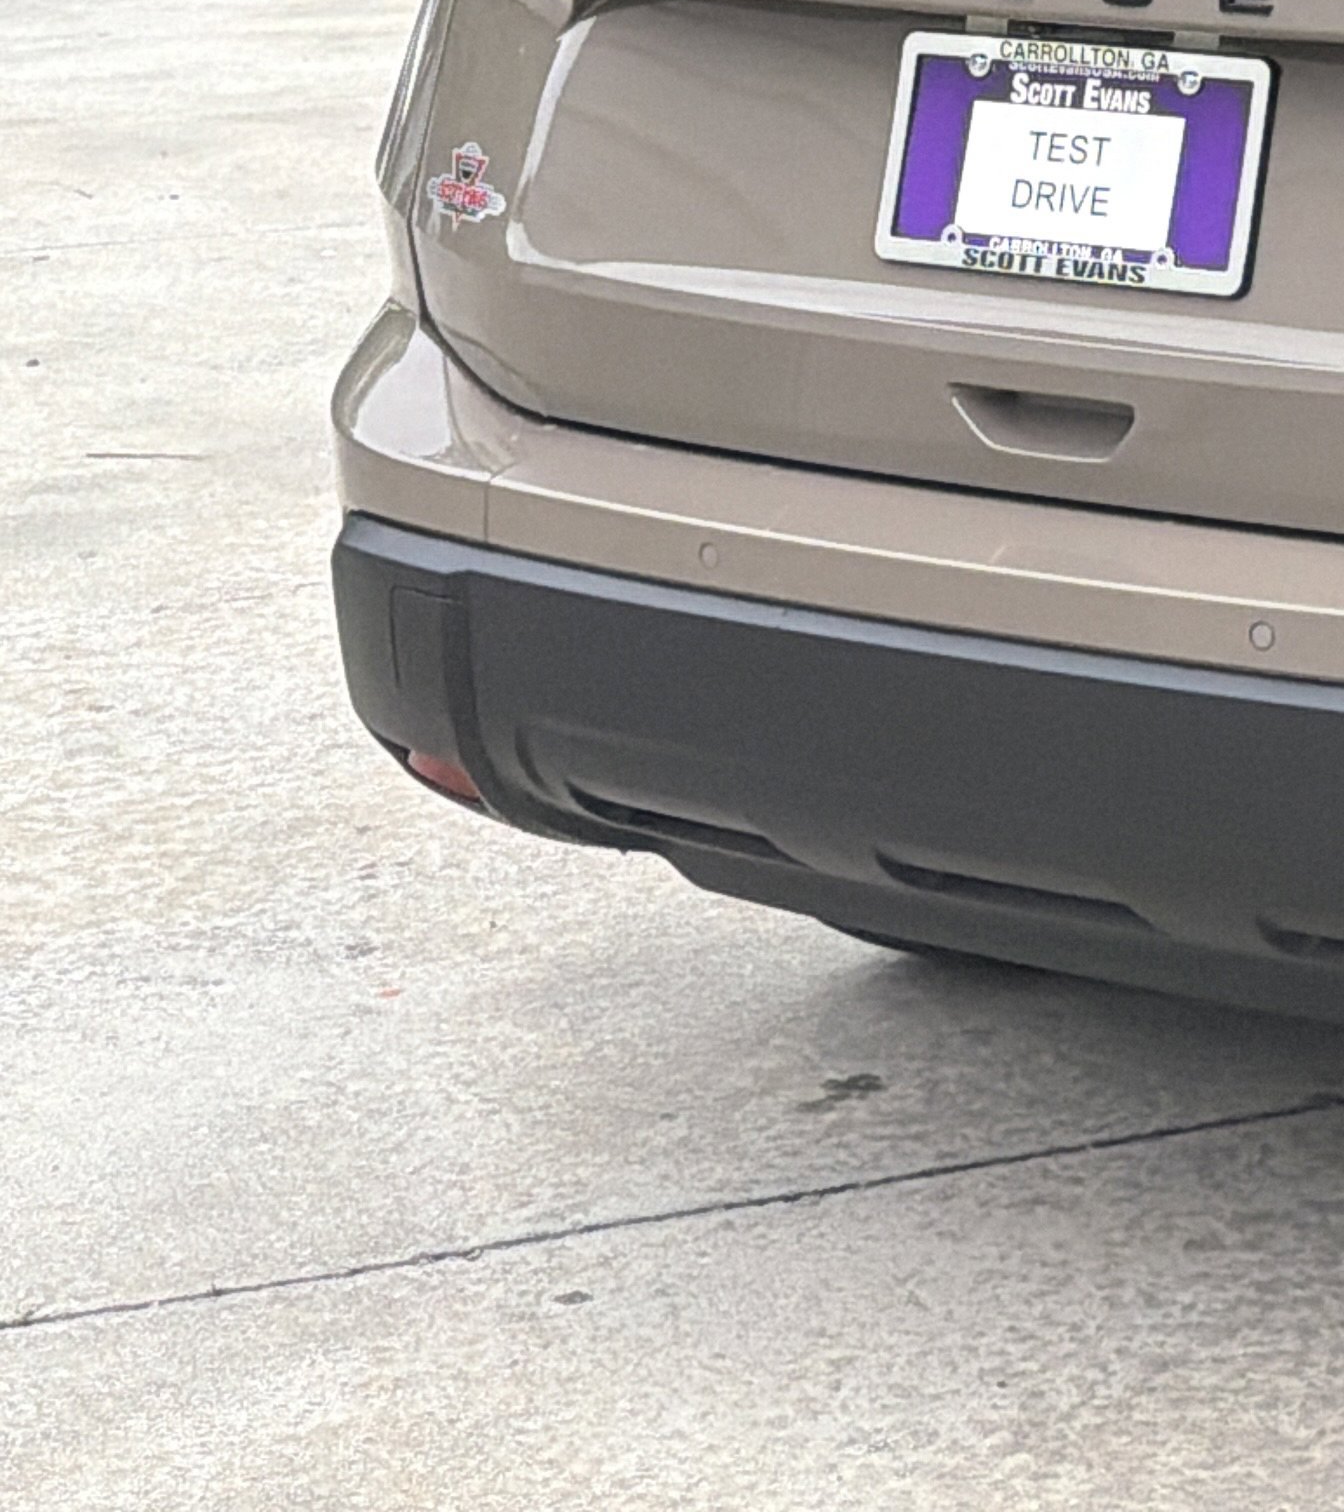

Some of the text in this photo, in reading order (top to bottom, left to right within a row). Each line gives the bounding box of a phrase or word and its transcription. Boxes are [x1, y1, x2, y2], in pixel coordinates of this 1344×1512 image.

[1140, 51, 1170, 72] GA
[1029, 130, 1112, 167] TEST
[1010, 178, 1111, 218] DRIVE
[961, 247, 1149, 285] SCOTT EVANS
